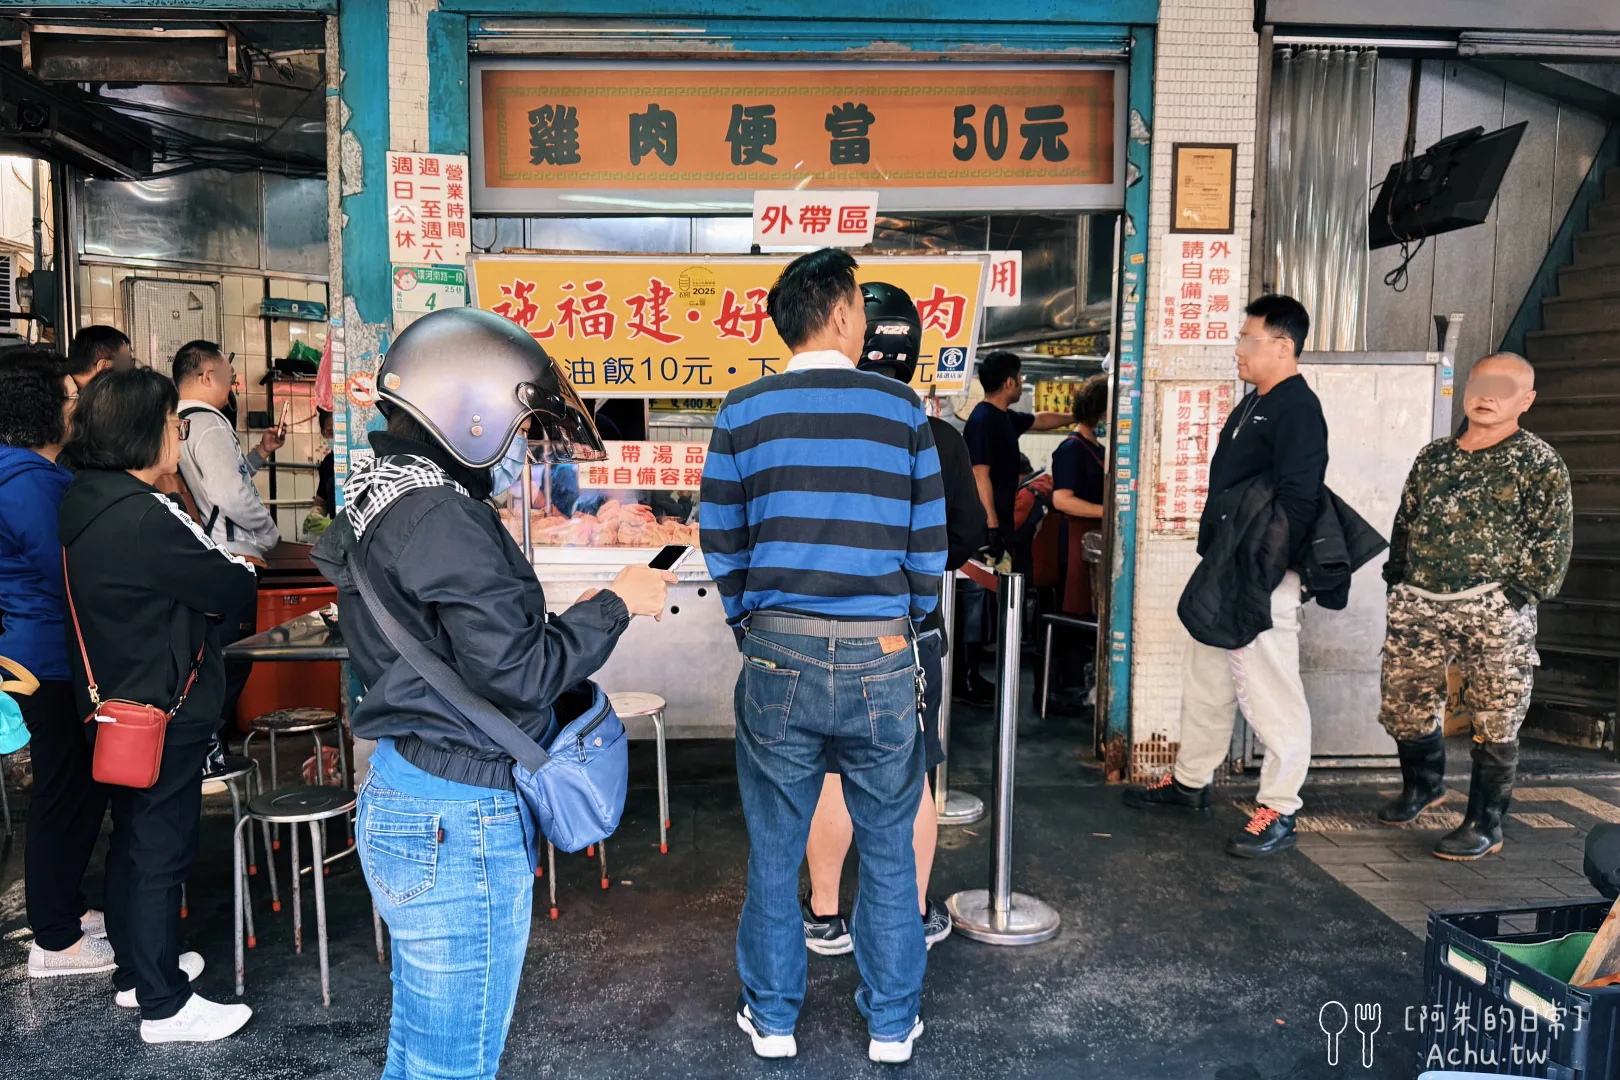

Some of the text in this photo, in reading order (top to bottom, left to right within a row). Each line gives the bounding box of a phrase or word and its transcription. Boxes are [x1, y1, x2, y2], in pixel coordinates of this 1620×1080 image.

[527, 102, 1069, 166] 雞肉便當 50元
[391, 156, 416, 248] 週日公休
[418, 157, 443, 261] 週一至週六
[761, 205, 870, 234] 外帶區
[692, 287, 716, 295] 2025
[990, 259, 1017, 297] 用
[1179, 240, 1204, 339] 請自備容器
[1206, 240, 1232, 339] 外帶湯品
[425, 292, 437, 310] 4
[874, 325, 911, 335] M2R
[620, 445, 704, 465] 帶湯品
[588, 467, 702, 487] 請自備容器
